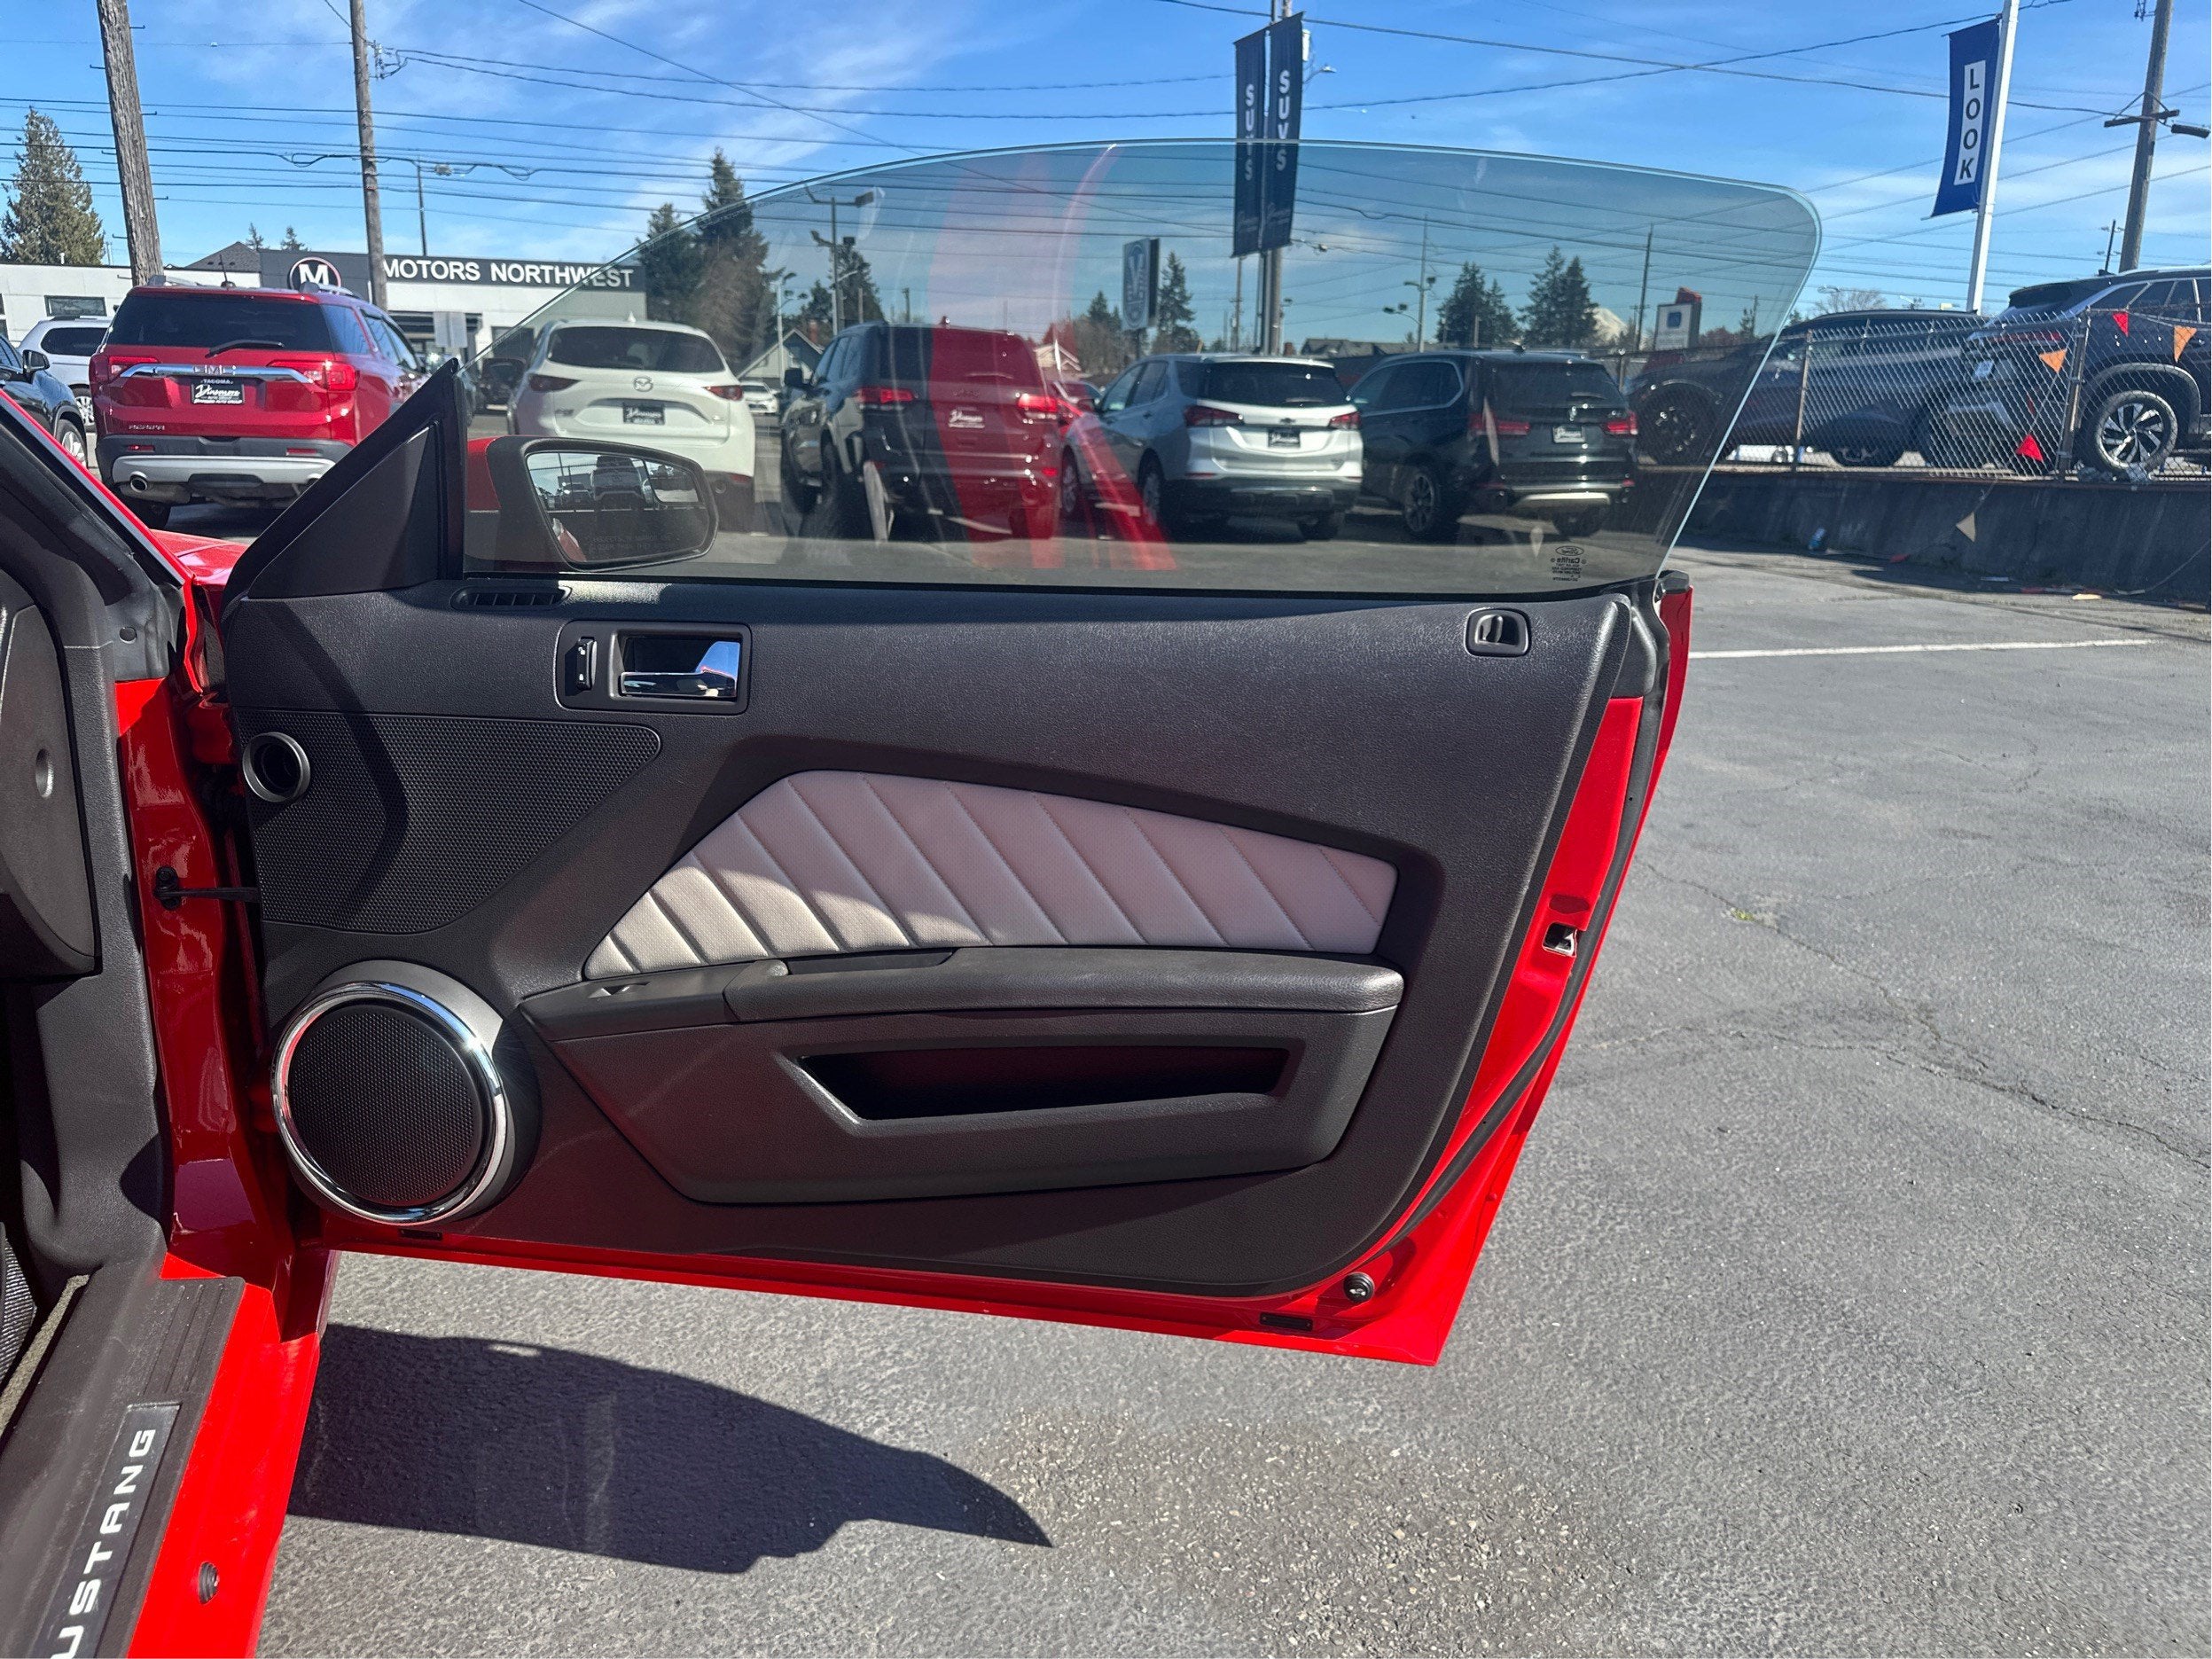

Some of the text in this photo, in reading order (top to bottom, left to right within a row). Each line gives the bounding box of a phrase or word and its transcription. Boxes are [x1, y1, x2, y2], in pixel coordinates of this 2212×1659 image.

[1959, 68, 1981, 180] LOOK
[299, 263, 329, 286] M
[383, 258, 634, 288] MOTORS NORTHWEST
